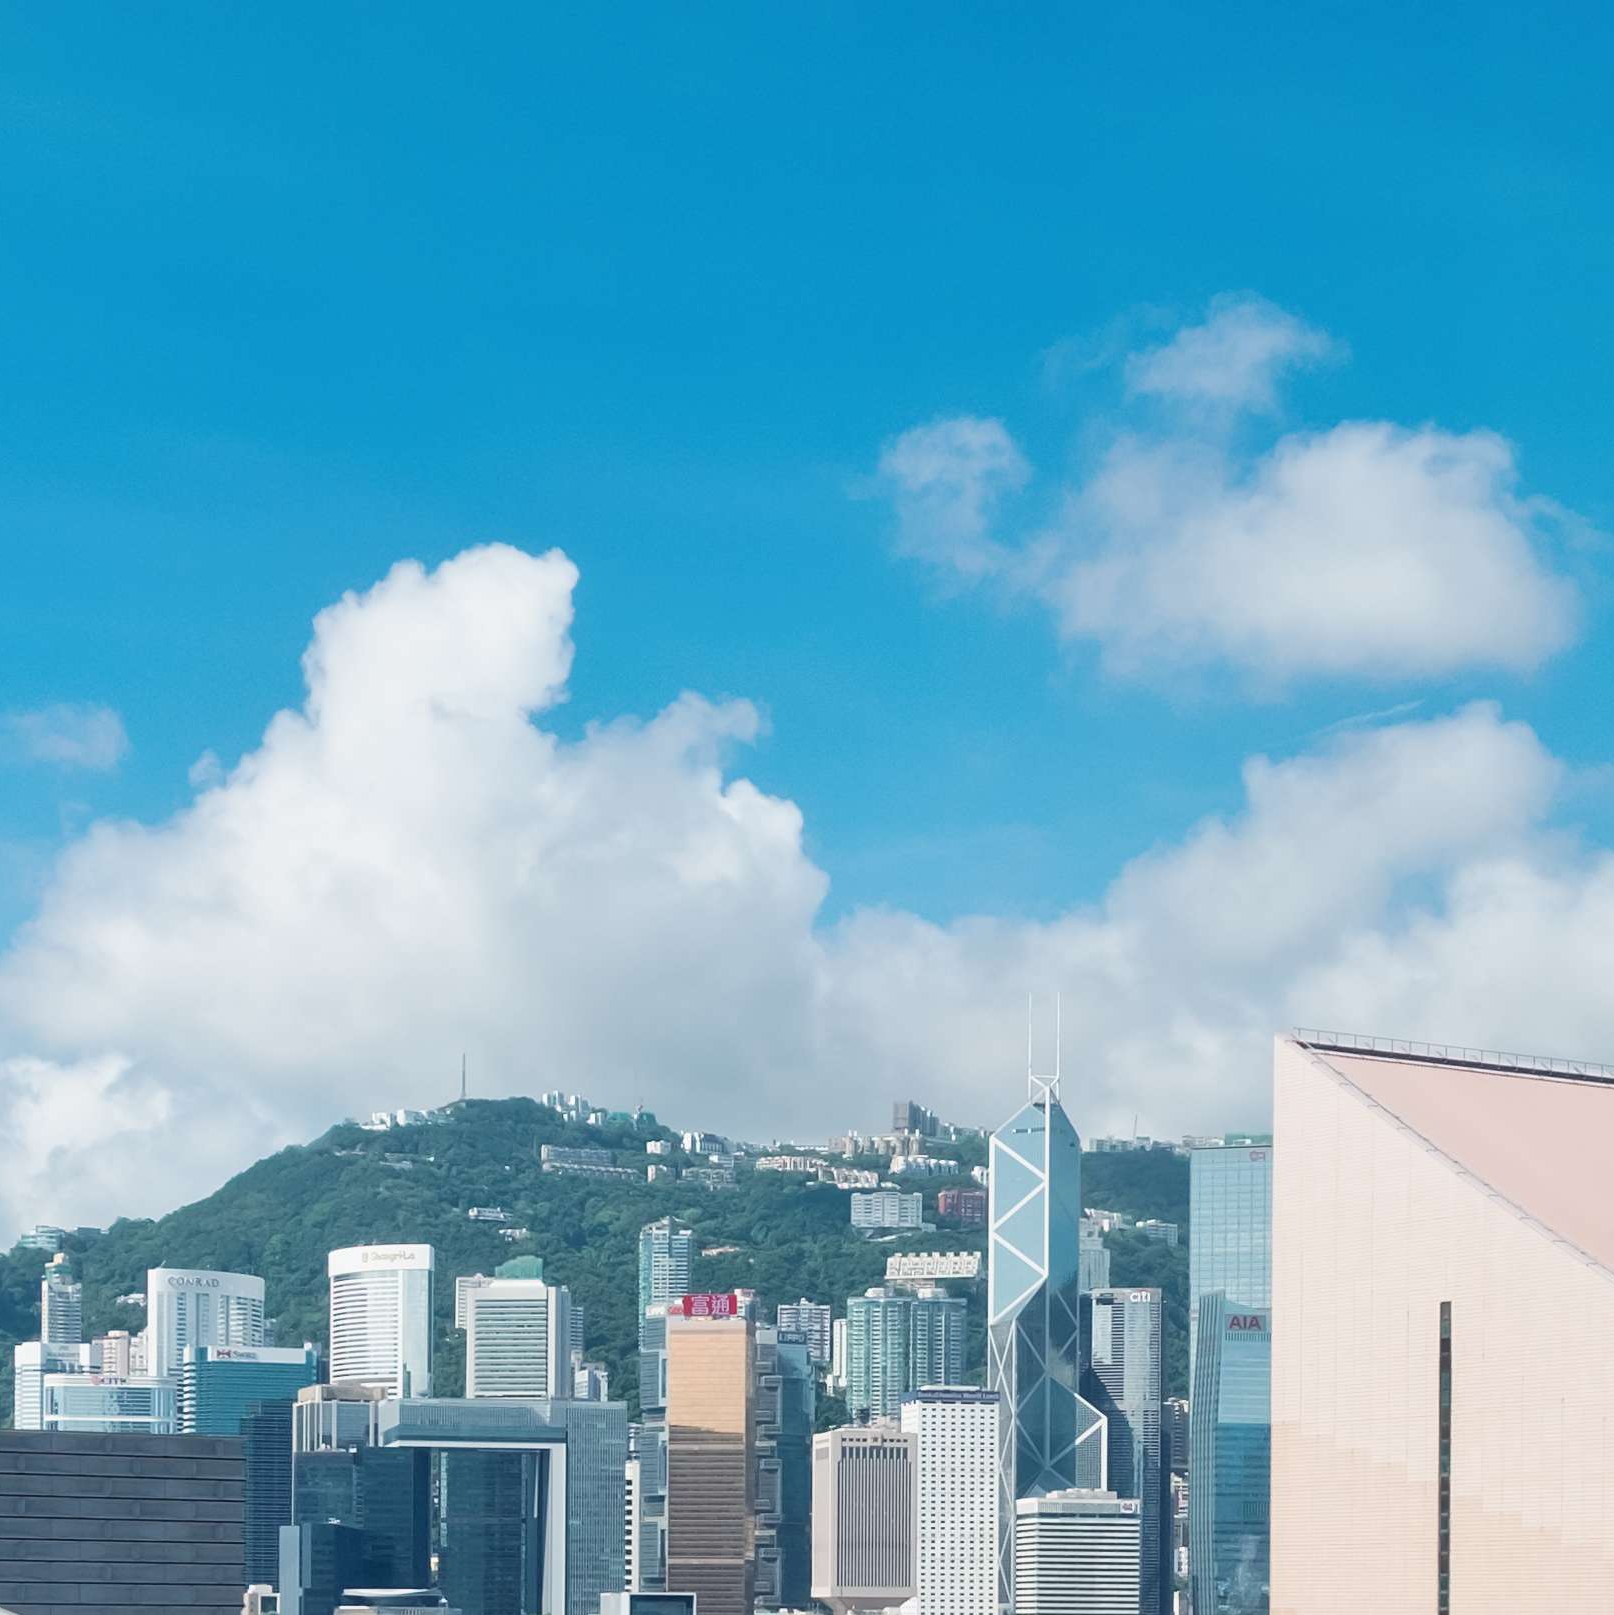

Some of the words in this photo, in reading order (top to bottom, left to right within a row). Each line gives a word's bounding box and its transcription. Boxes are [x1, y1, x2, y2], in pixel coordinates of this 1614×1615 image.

[167, 1276, 219, 1288] CONRAD
[1130, 1291, 1151, 1303] citi
[691, 1295, 730, 1315] 富通
[1228, 1315, 1262, 1330] AIA
